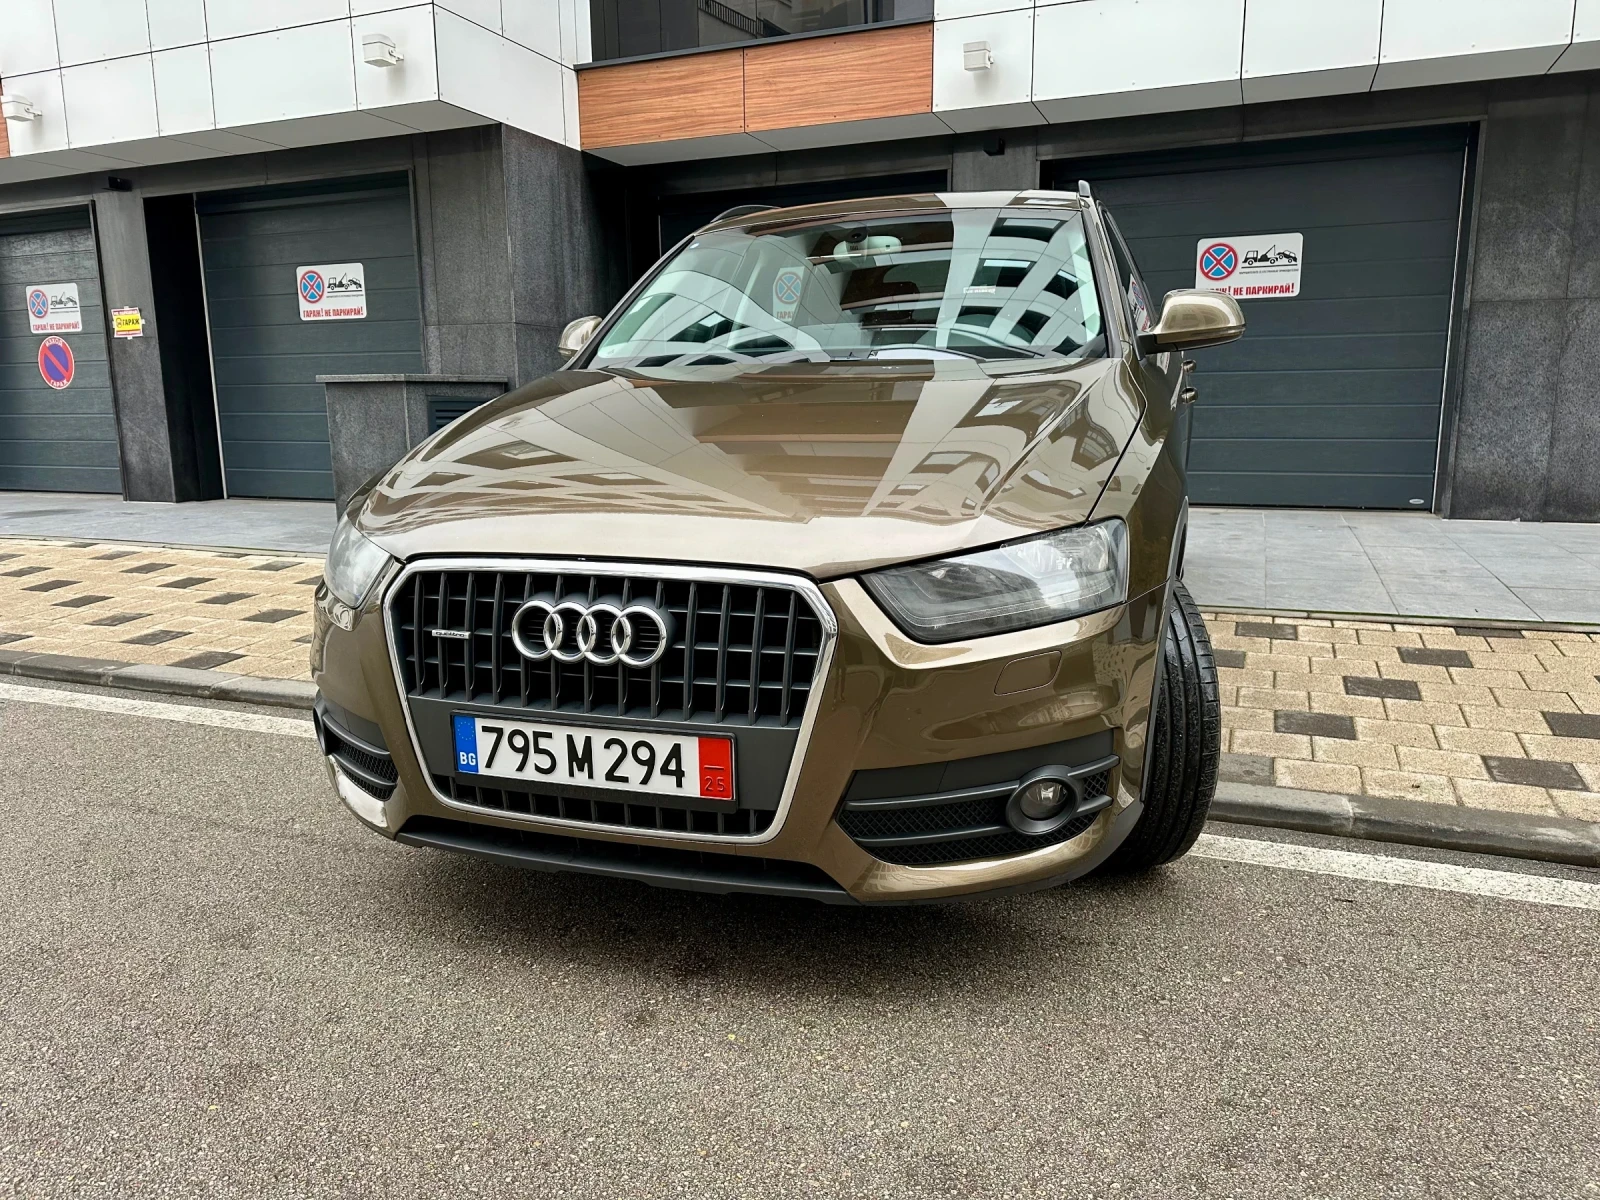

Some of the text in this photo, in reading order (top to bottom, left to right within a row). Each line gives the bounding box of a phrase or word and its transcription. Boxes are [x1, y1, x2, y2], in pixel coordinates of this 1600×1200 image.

[1233, 287, 1243, 296] НЕ
[1246, 282, 1295, 296] ПАРКИРАЙ!
[303, 306, 364, 318] ГАРАЖ! НЕ ПАРКИРАЙ!
[460, 751, 476, 766] BG
[481, 725, 686, 788] 795 M 294
[704, 775, 725, 792] 25
